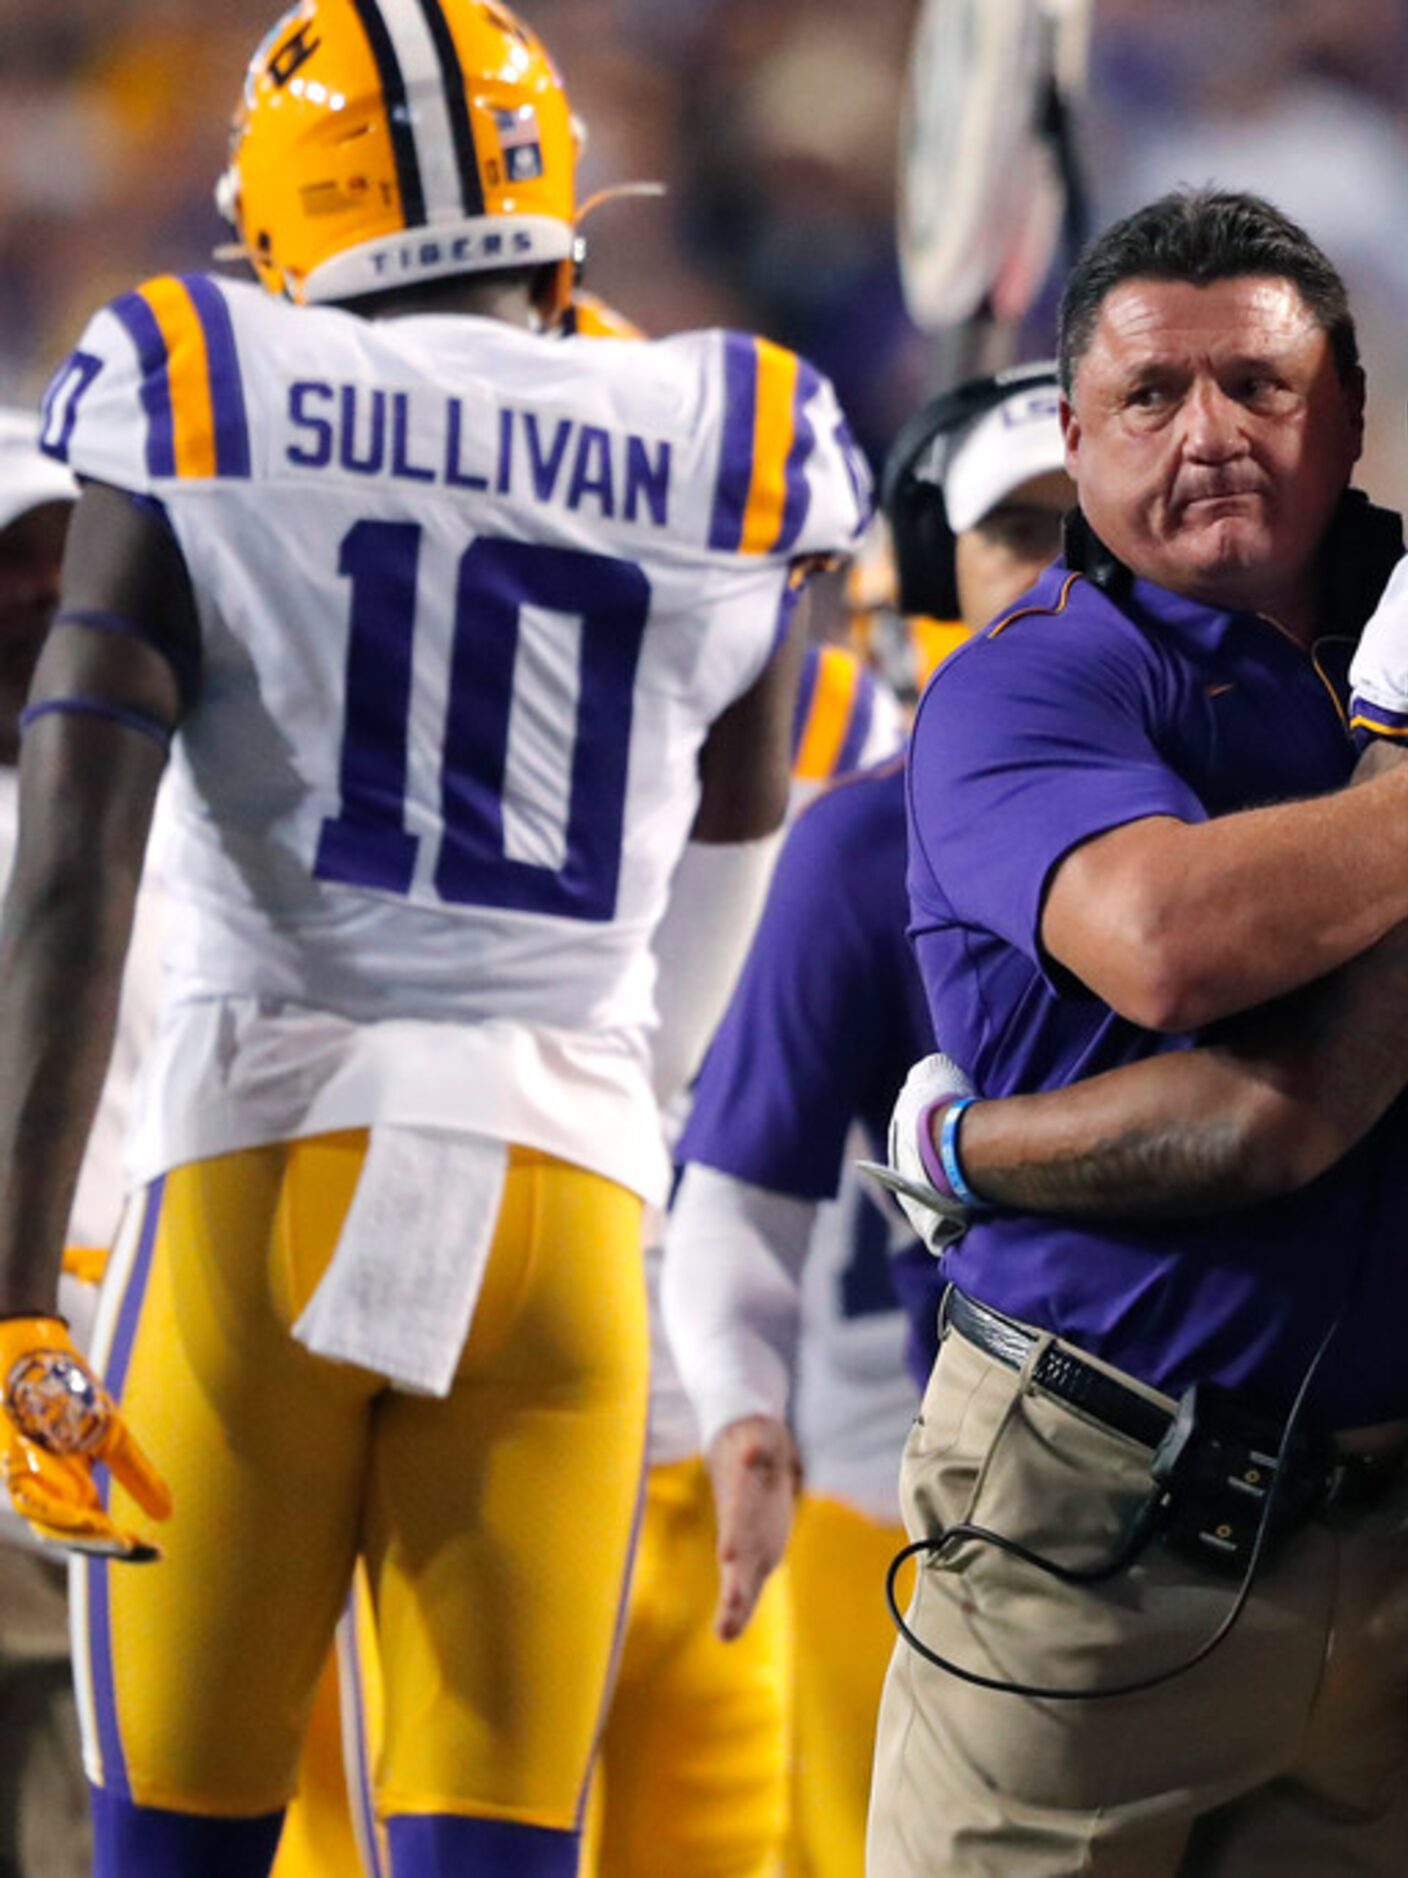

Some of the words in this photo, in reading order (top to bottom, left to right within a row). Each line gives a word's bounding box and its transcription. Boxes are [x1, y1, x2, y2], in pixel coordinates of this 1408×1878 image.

[368, 231, 532, 273] TIGERS
[286, 381, 672, 527] SULLIVAN
[312, 519, 651, 922] 10
